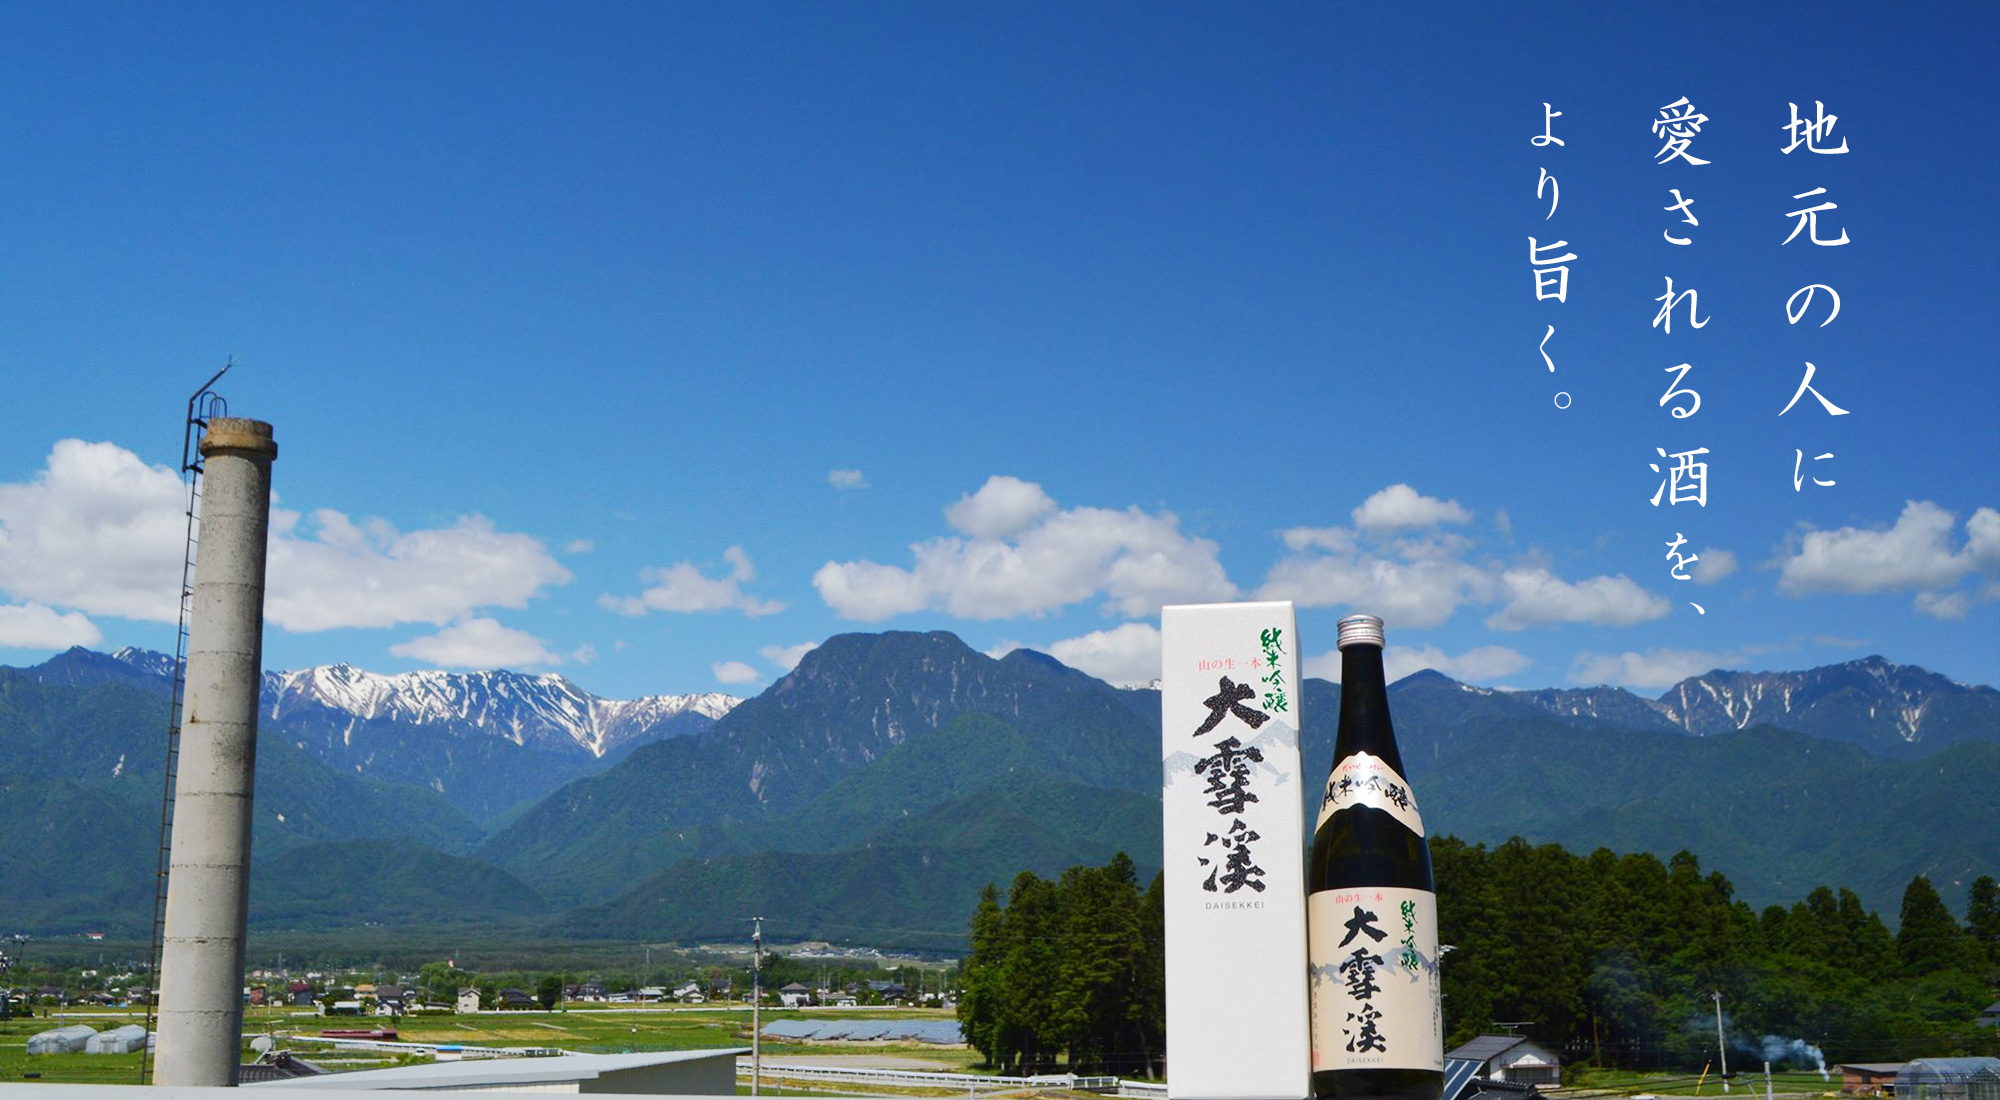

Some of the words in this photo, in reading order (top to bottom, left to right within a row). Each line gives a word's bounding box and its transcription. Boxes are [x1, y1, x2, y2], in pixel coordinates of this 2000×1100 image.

[1197, 656, 1262, 672] 山の生一本
[1335, 893, 1385, 905] 山の生一本
[1205, 901, 1265, 911] DAISEKKEI
